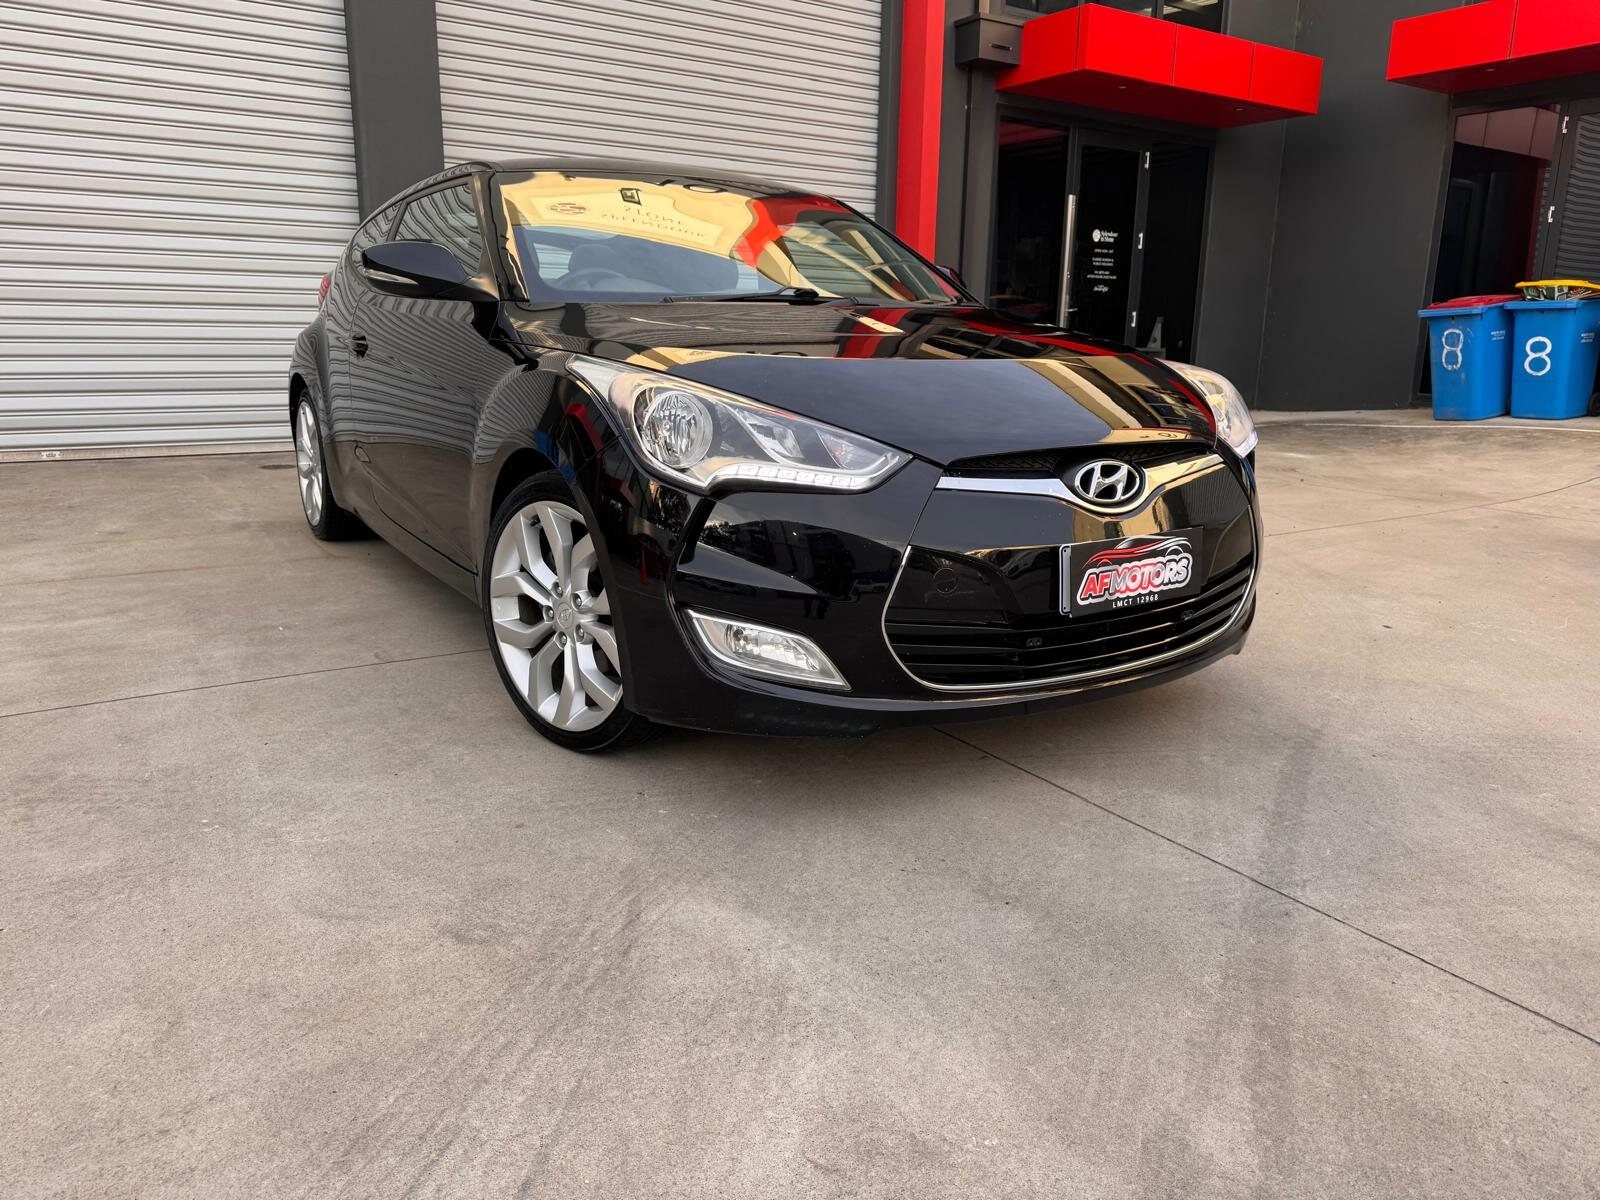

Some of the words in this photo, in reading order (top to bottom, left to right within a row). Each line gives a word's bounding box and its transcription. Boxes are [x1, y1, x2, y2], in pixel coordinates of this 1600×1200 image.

[1442, 328, 1464, 371] 8
[1524, 336, 1552, 376] 8
[1112, 598, 1133, 609] LMCT
